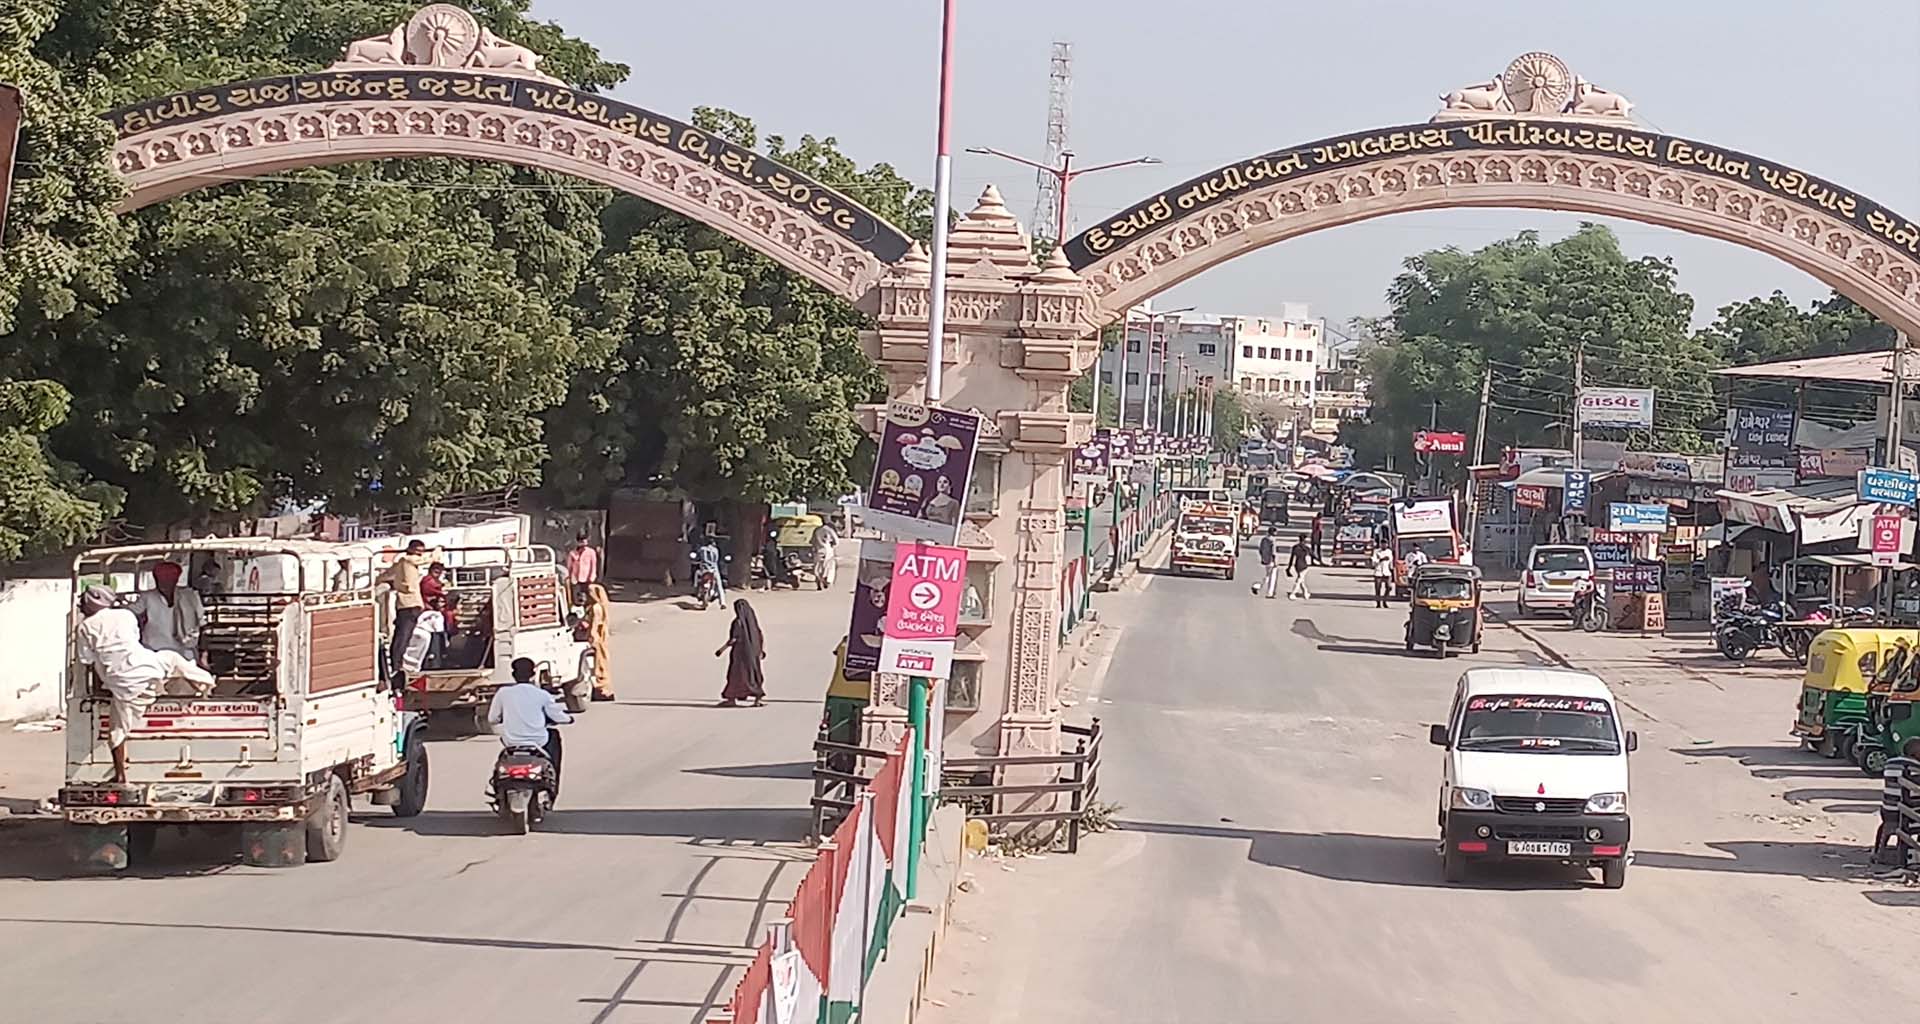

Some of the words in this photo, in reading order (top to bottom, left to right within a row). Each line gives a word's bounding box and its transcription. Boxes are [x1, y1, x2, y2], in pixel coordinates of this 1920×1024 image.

[117, 94, 222, 134] હાવીર
[418, 76, 513, 102] જયંત
[1312, 129, 1454, 163] ગગલદાસ
[1666, 139, 1751, 180] દિવાન
[1430, 439, 1464, 451] Amul
[1876, 519, 1900, 529] ATM
[898, 553, 961, 582] ATM
[899, 659, 924, 669] ATM
[1469, 698, 1509, 711] Raja
